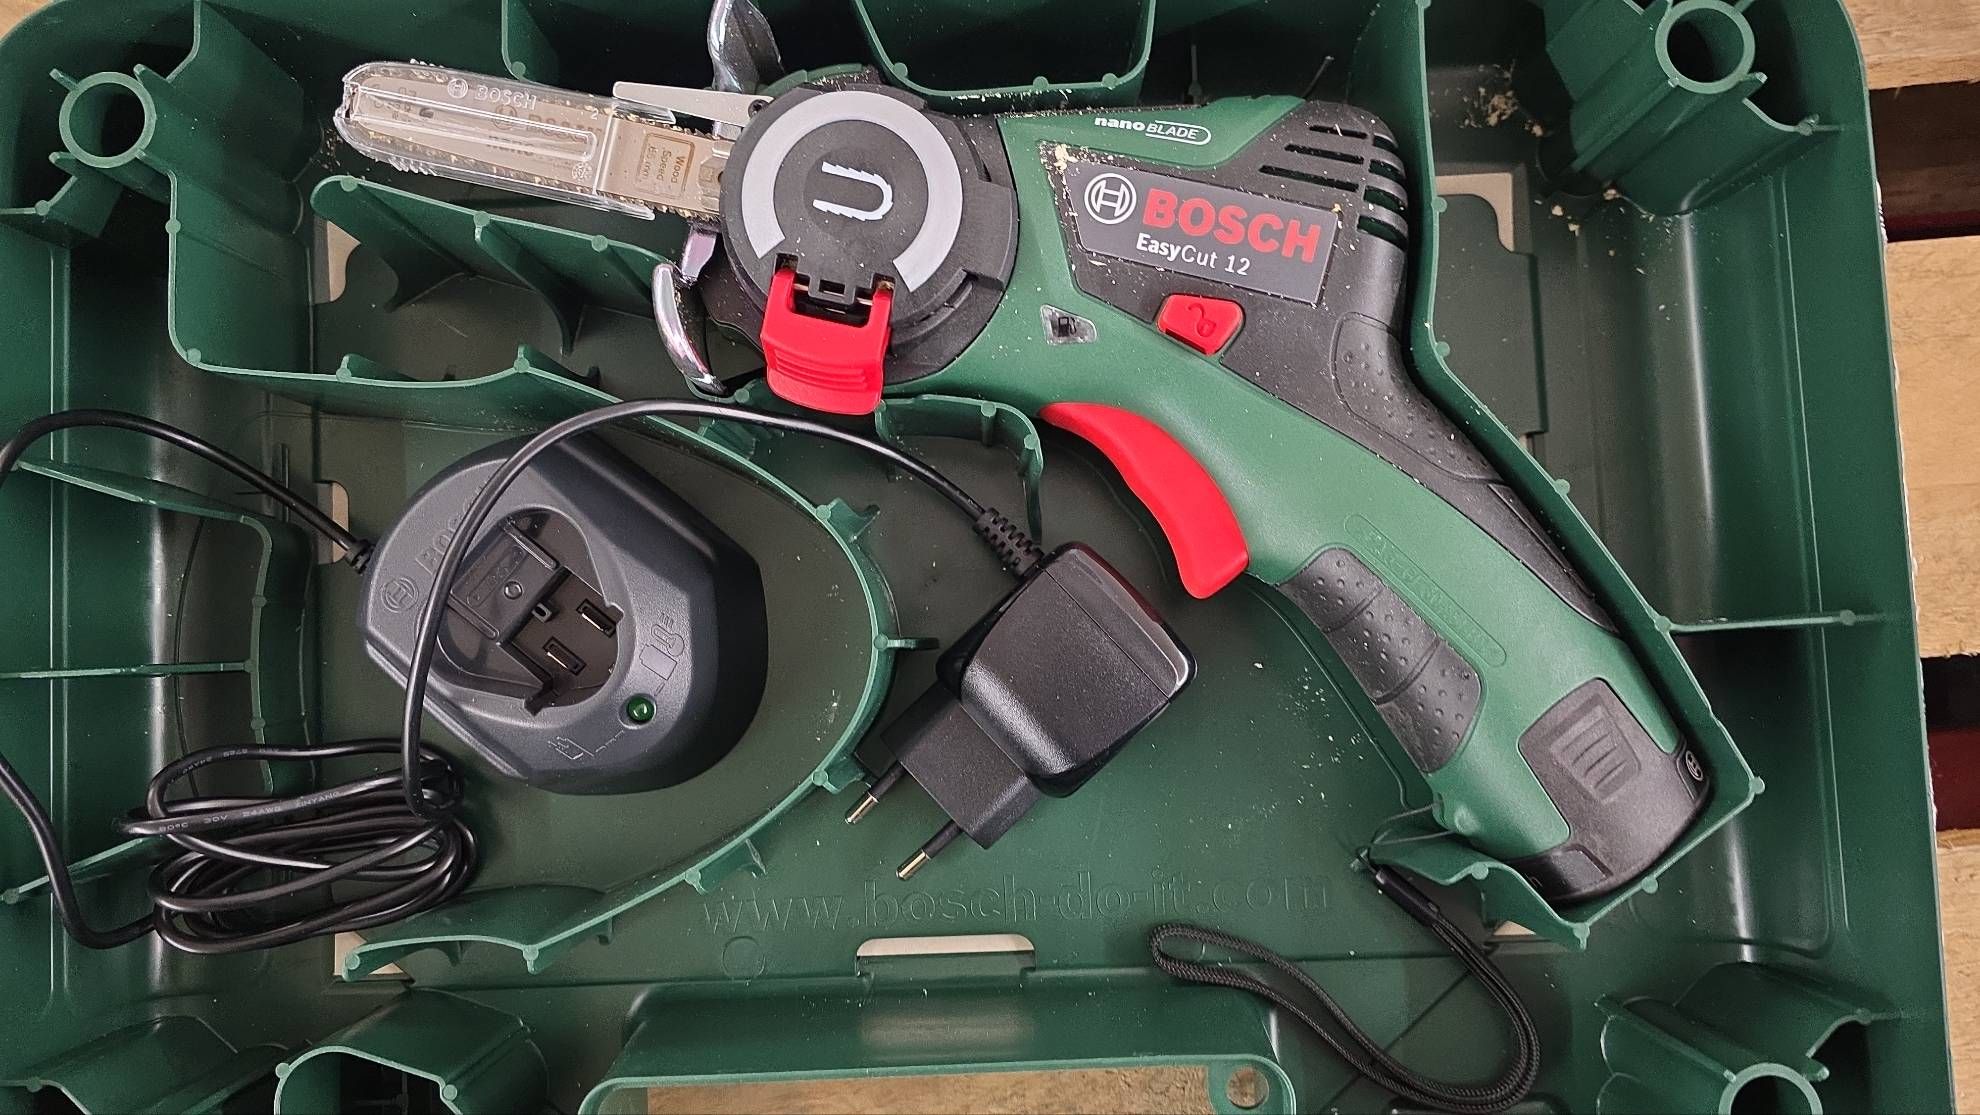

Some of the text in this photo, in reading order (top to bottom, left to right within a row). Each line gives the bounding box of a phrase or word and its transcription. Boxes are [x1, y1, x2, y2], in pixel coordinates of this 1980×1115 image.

[476, 84, 537, 110] BOSCH
[1141, 187, 1322, 264] BOSCH
[1135, 232, 1252, 277] EasyCut 12
